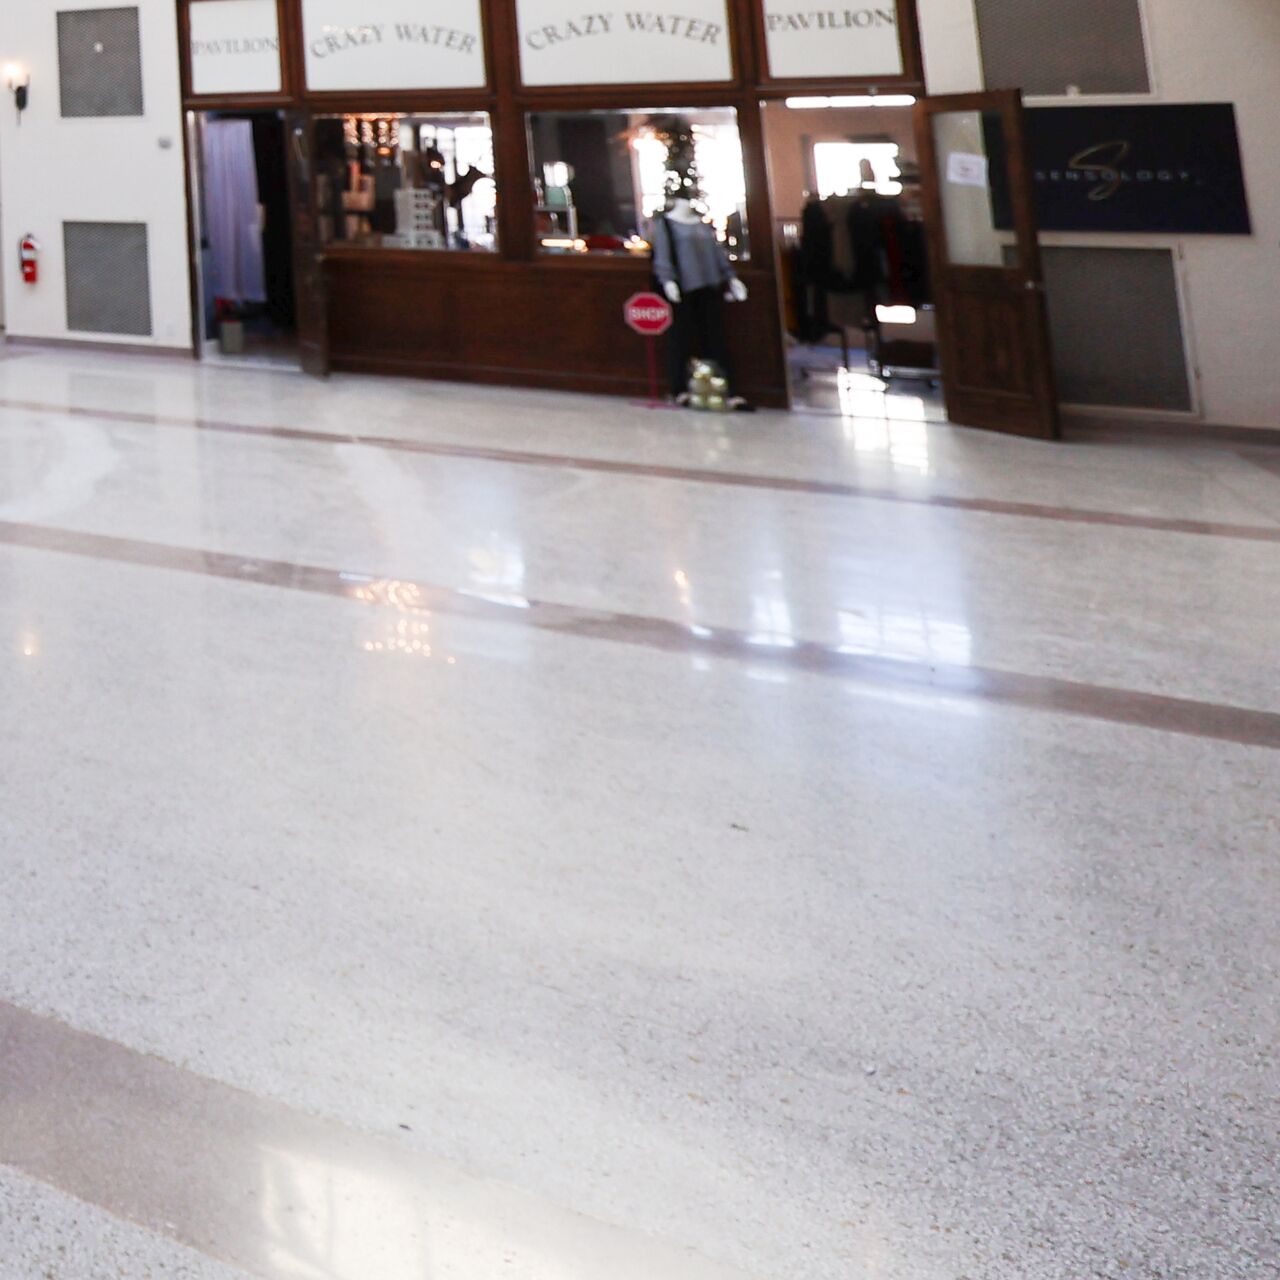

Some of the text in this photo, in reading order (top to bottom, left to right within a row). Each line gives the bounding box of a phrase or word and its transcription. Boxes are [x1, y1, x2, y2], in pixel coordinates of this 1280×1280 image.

[525, 11, 722, 52] CRAZY WATER
[766, 7, 897, 33] PAVILION
[192, 36, 280, 56] PAVILION
[309, 23, 477, 59] CRAZY WATER
